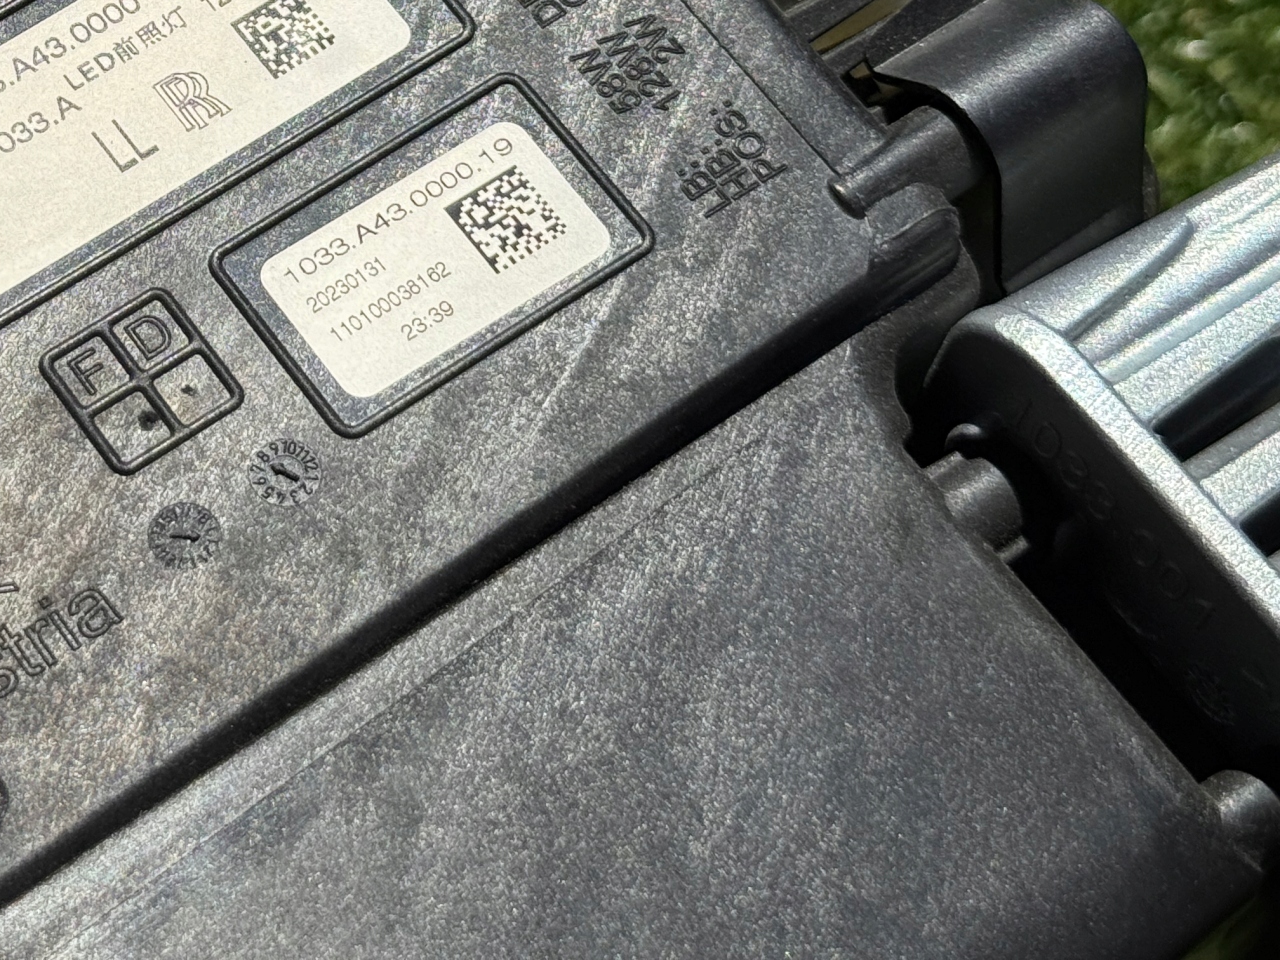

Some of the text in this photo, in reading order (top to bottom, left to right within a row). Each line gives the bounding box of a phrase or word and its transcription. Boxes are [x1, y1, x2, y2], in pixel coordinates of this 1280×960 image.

[567, 43, 642, 118] 58W
[596, 25, 682, 114] 128W
[623, 9, 787, 184] POS: 2W
[91, 119, 159, 173] LL
[284, 136, 514, 285] 1033.A43.0000.19
[305, 256, 388, 313] 20230131
[329, 261, 453, 343] 110100038162
[401, 300, 456, 342] 23:39
[123, 313, 172, 361] D
